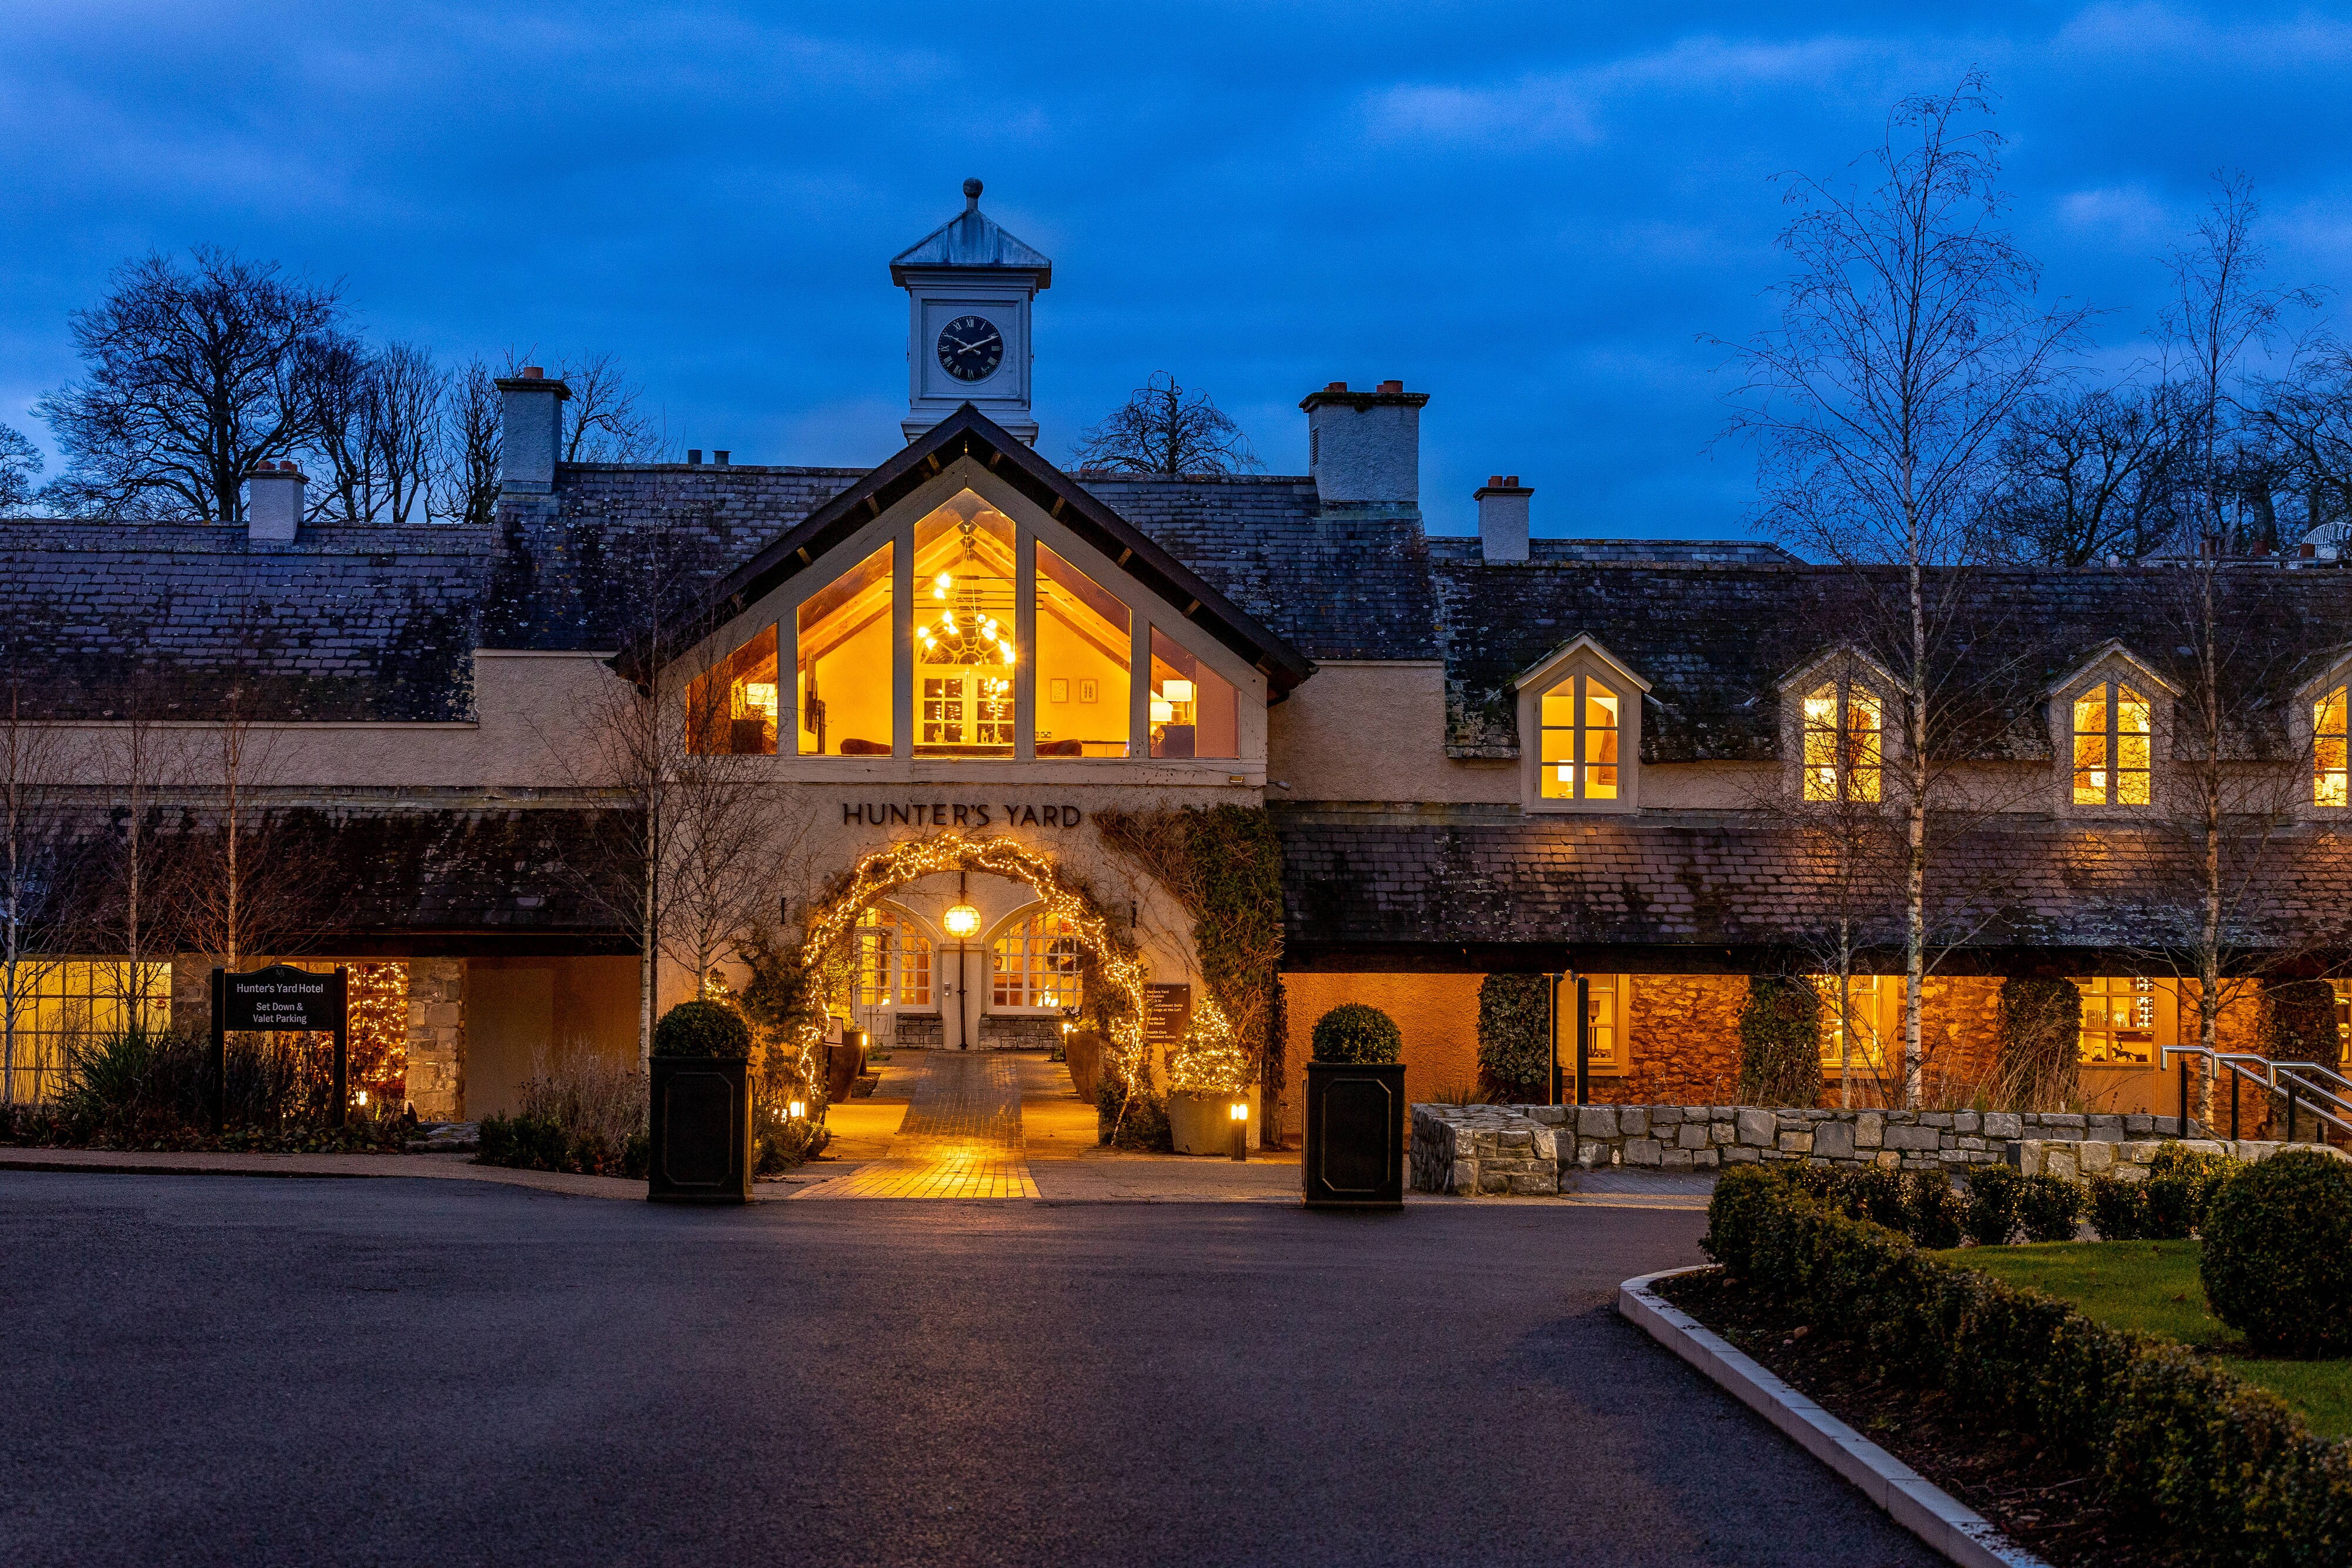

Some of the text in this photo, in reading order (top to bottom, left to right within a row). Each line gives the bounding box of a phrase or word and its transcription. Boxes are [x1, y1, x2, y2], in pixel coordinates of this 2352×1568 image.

[966, 319, 974, 327] XII
[842, 803, 1081, 828] HUNTER'S YARD
[236, 984, 323, 993] Hunter's Yard Hotel
[256, 1002, 303, 1011] Set Down &
[253, 1014, 307, 1024] Valet Parking
